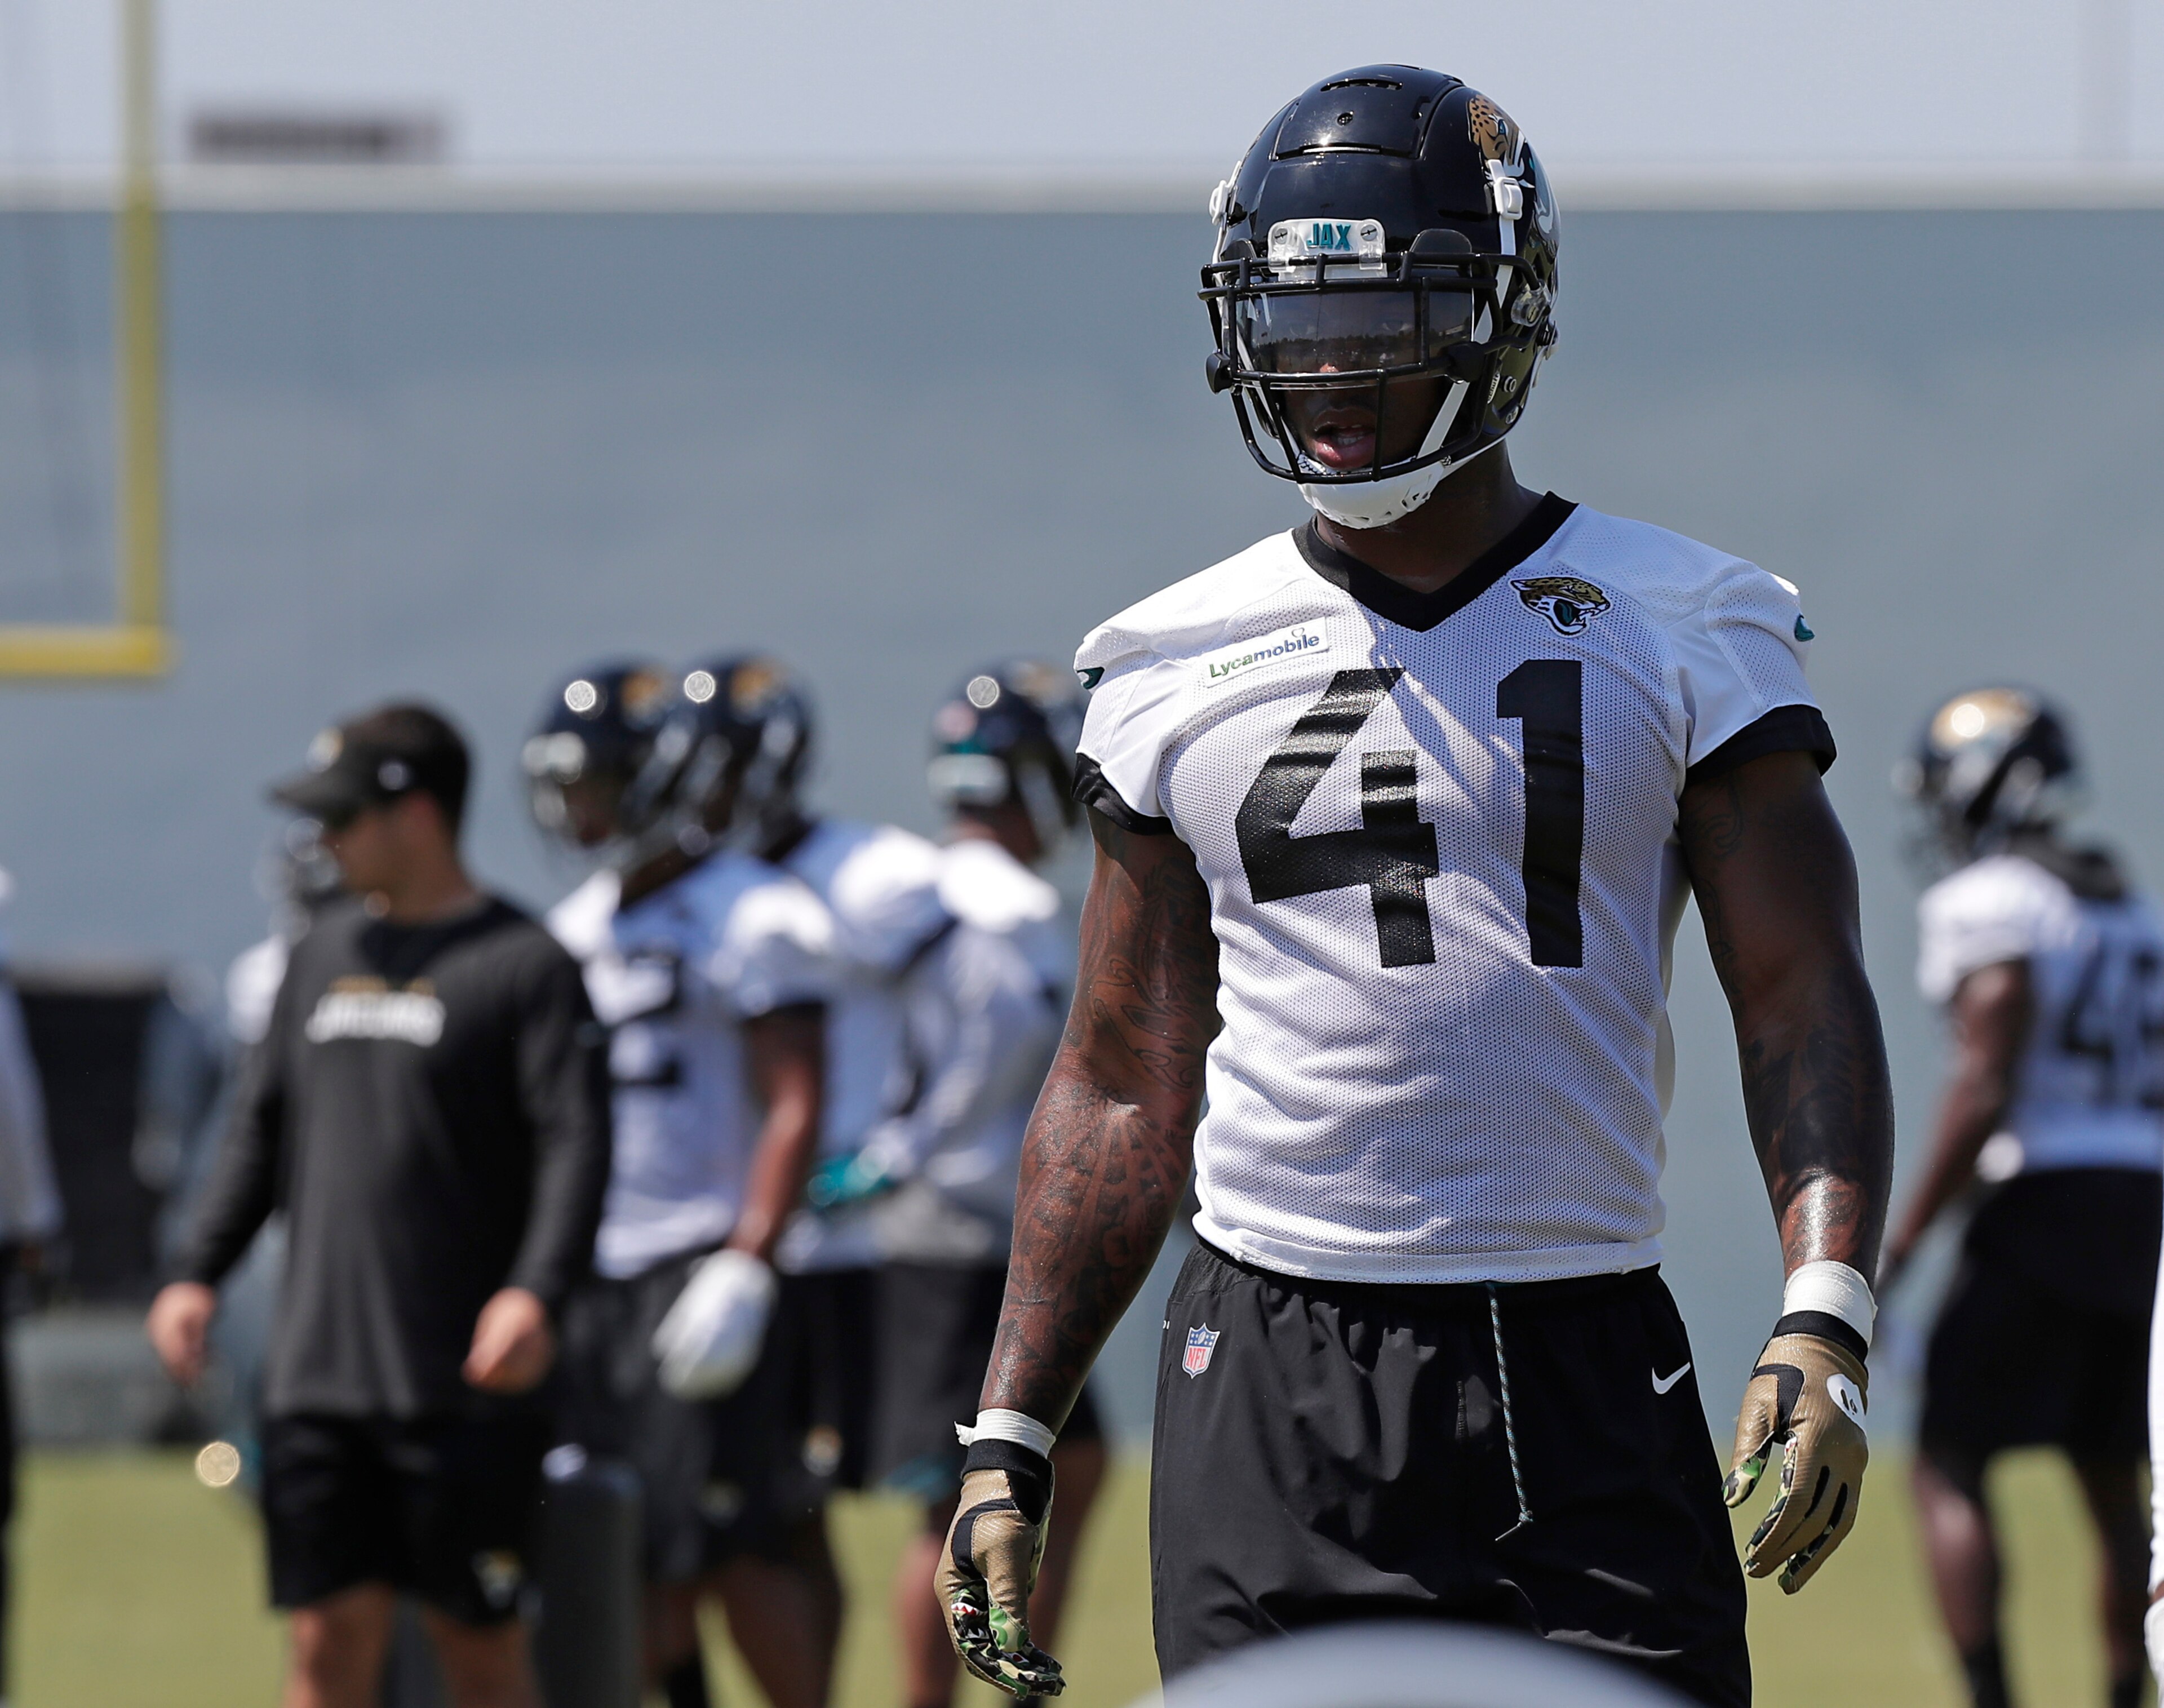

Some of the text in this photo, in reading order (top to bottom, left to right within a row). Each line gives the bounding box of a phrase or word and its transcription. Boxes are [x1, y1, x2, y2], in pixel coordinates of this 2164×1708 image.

[1306, 222, 1351, 251] JAX
[1209, 635, 1320, 678] Lycamobile
[1235, 659, 1584, 968] 41
[1186, 1347, 1207, 1370] NFL
